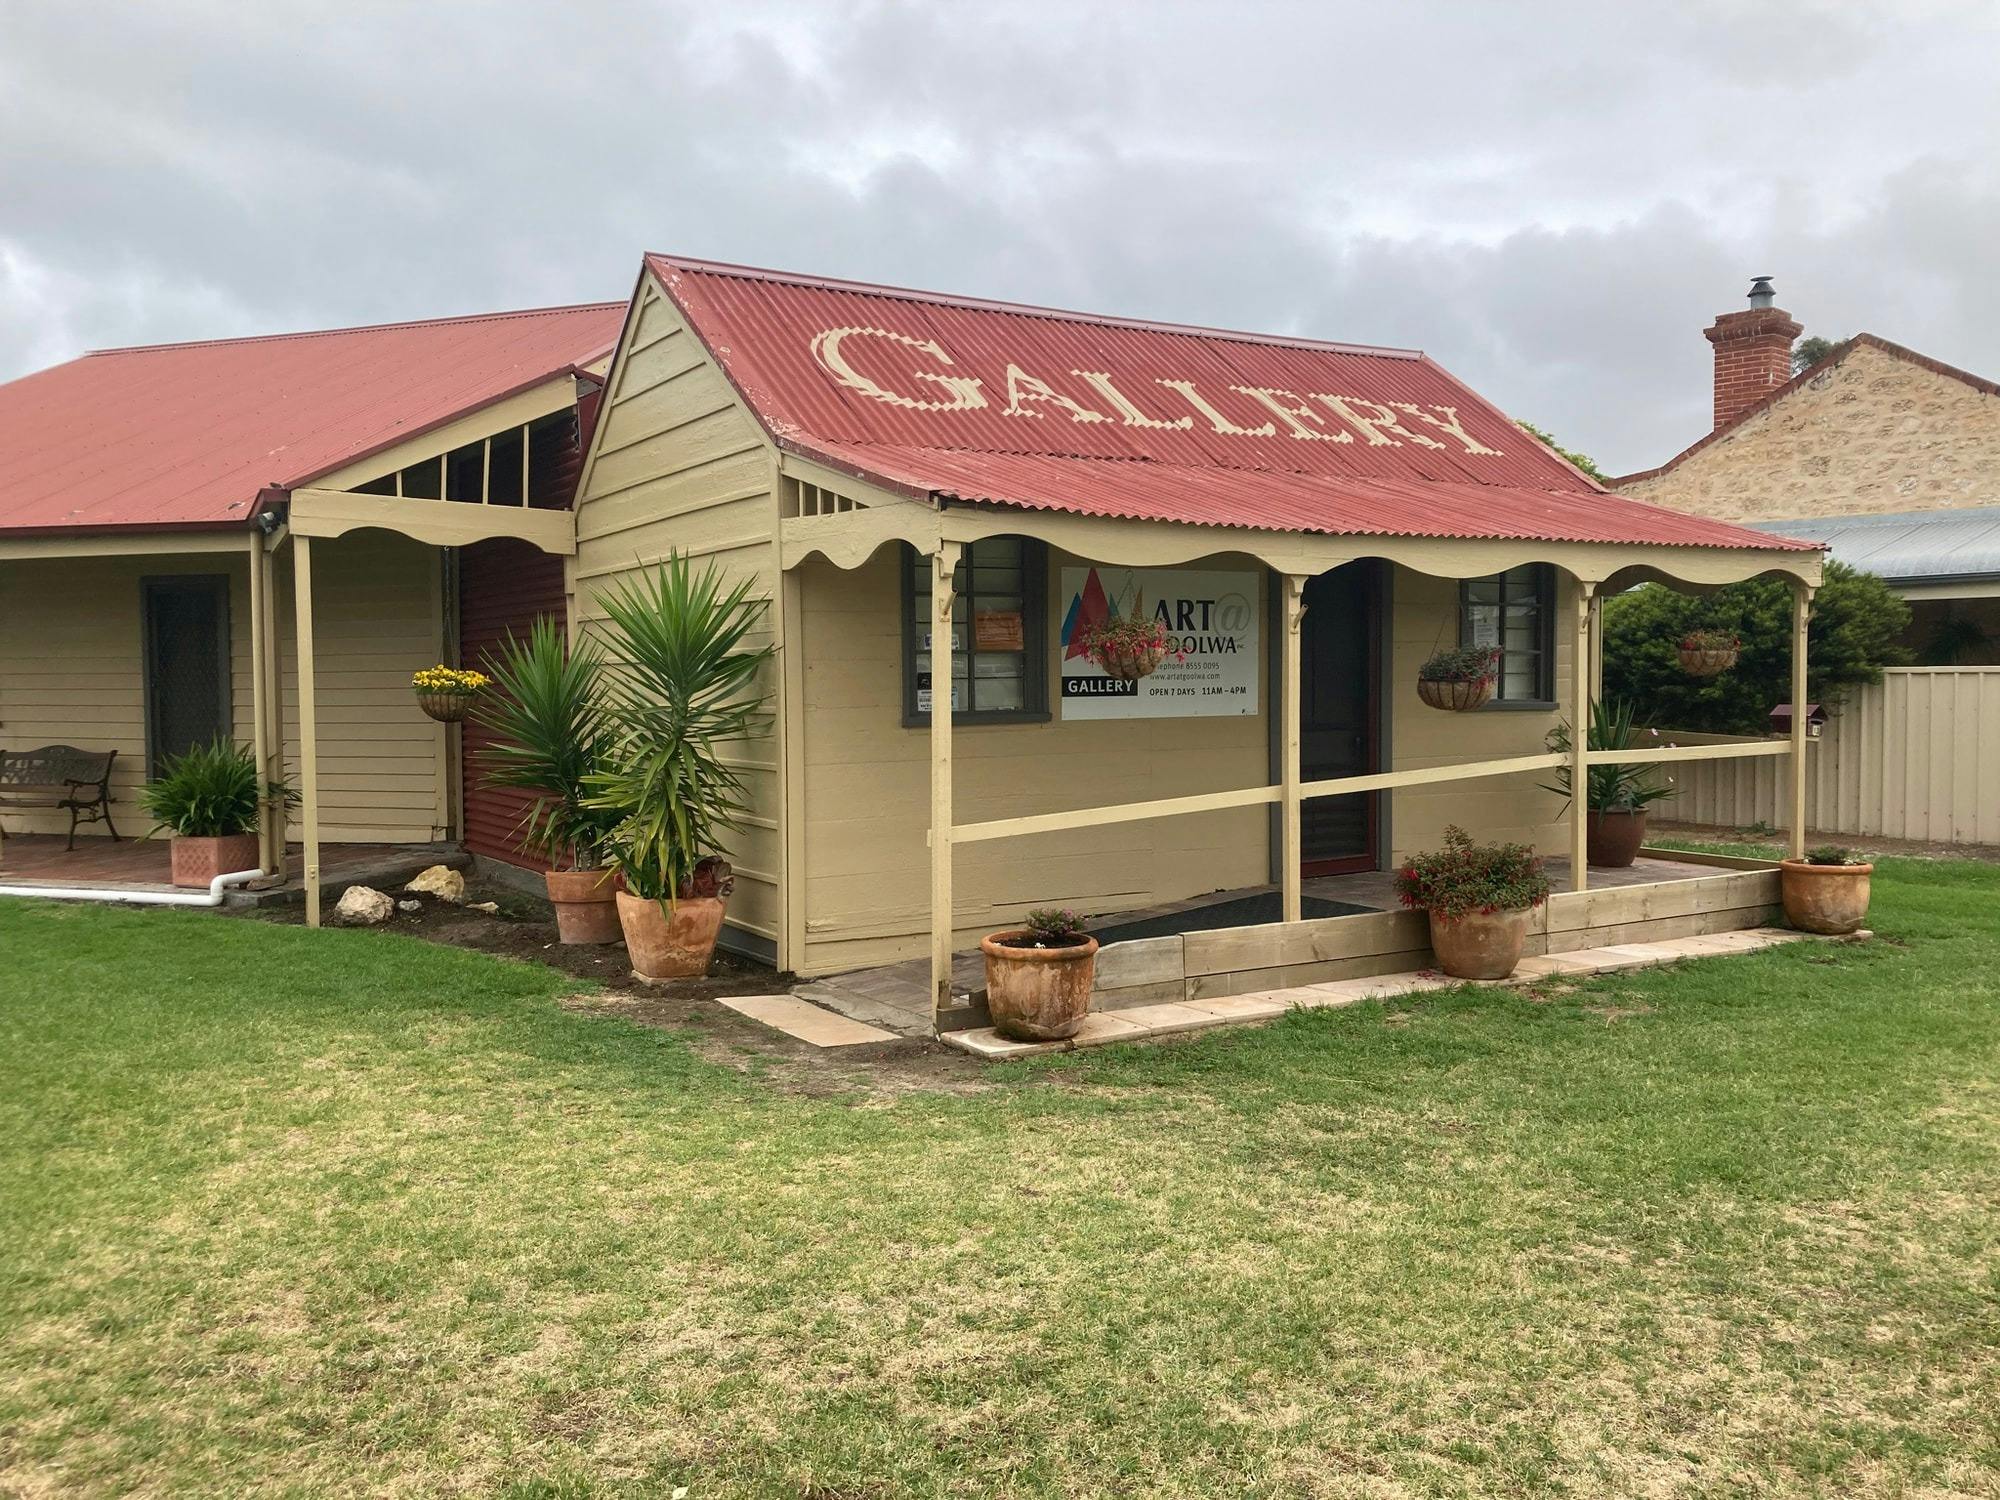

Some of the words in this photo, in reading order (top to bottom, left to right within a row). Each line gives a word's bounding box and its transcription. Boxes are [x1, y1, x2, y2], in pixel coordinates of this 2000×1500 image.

[809, 326, 1505, 457] GALLERY
[1166, 636, 1237, 654] OOLWA
[1185, 662, 1201, 670] 8555
[1068, 680, 1134, 693] GALLERY
[1149, 688, 1169, 696] OPEN
[1171, 688, 1175, 696] 7
[1177, 688, 1196, 696] DAYS
